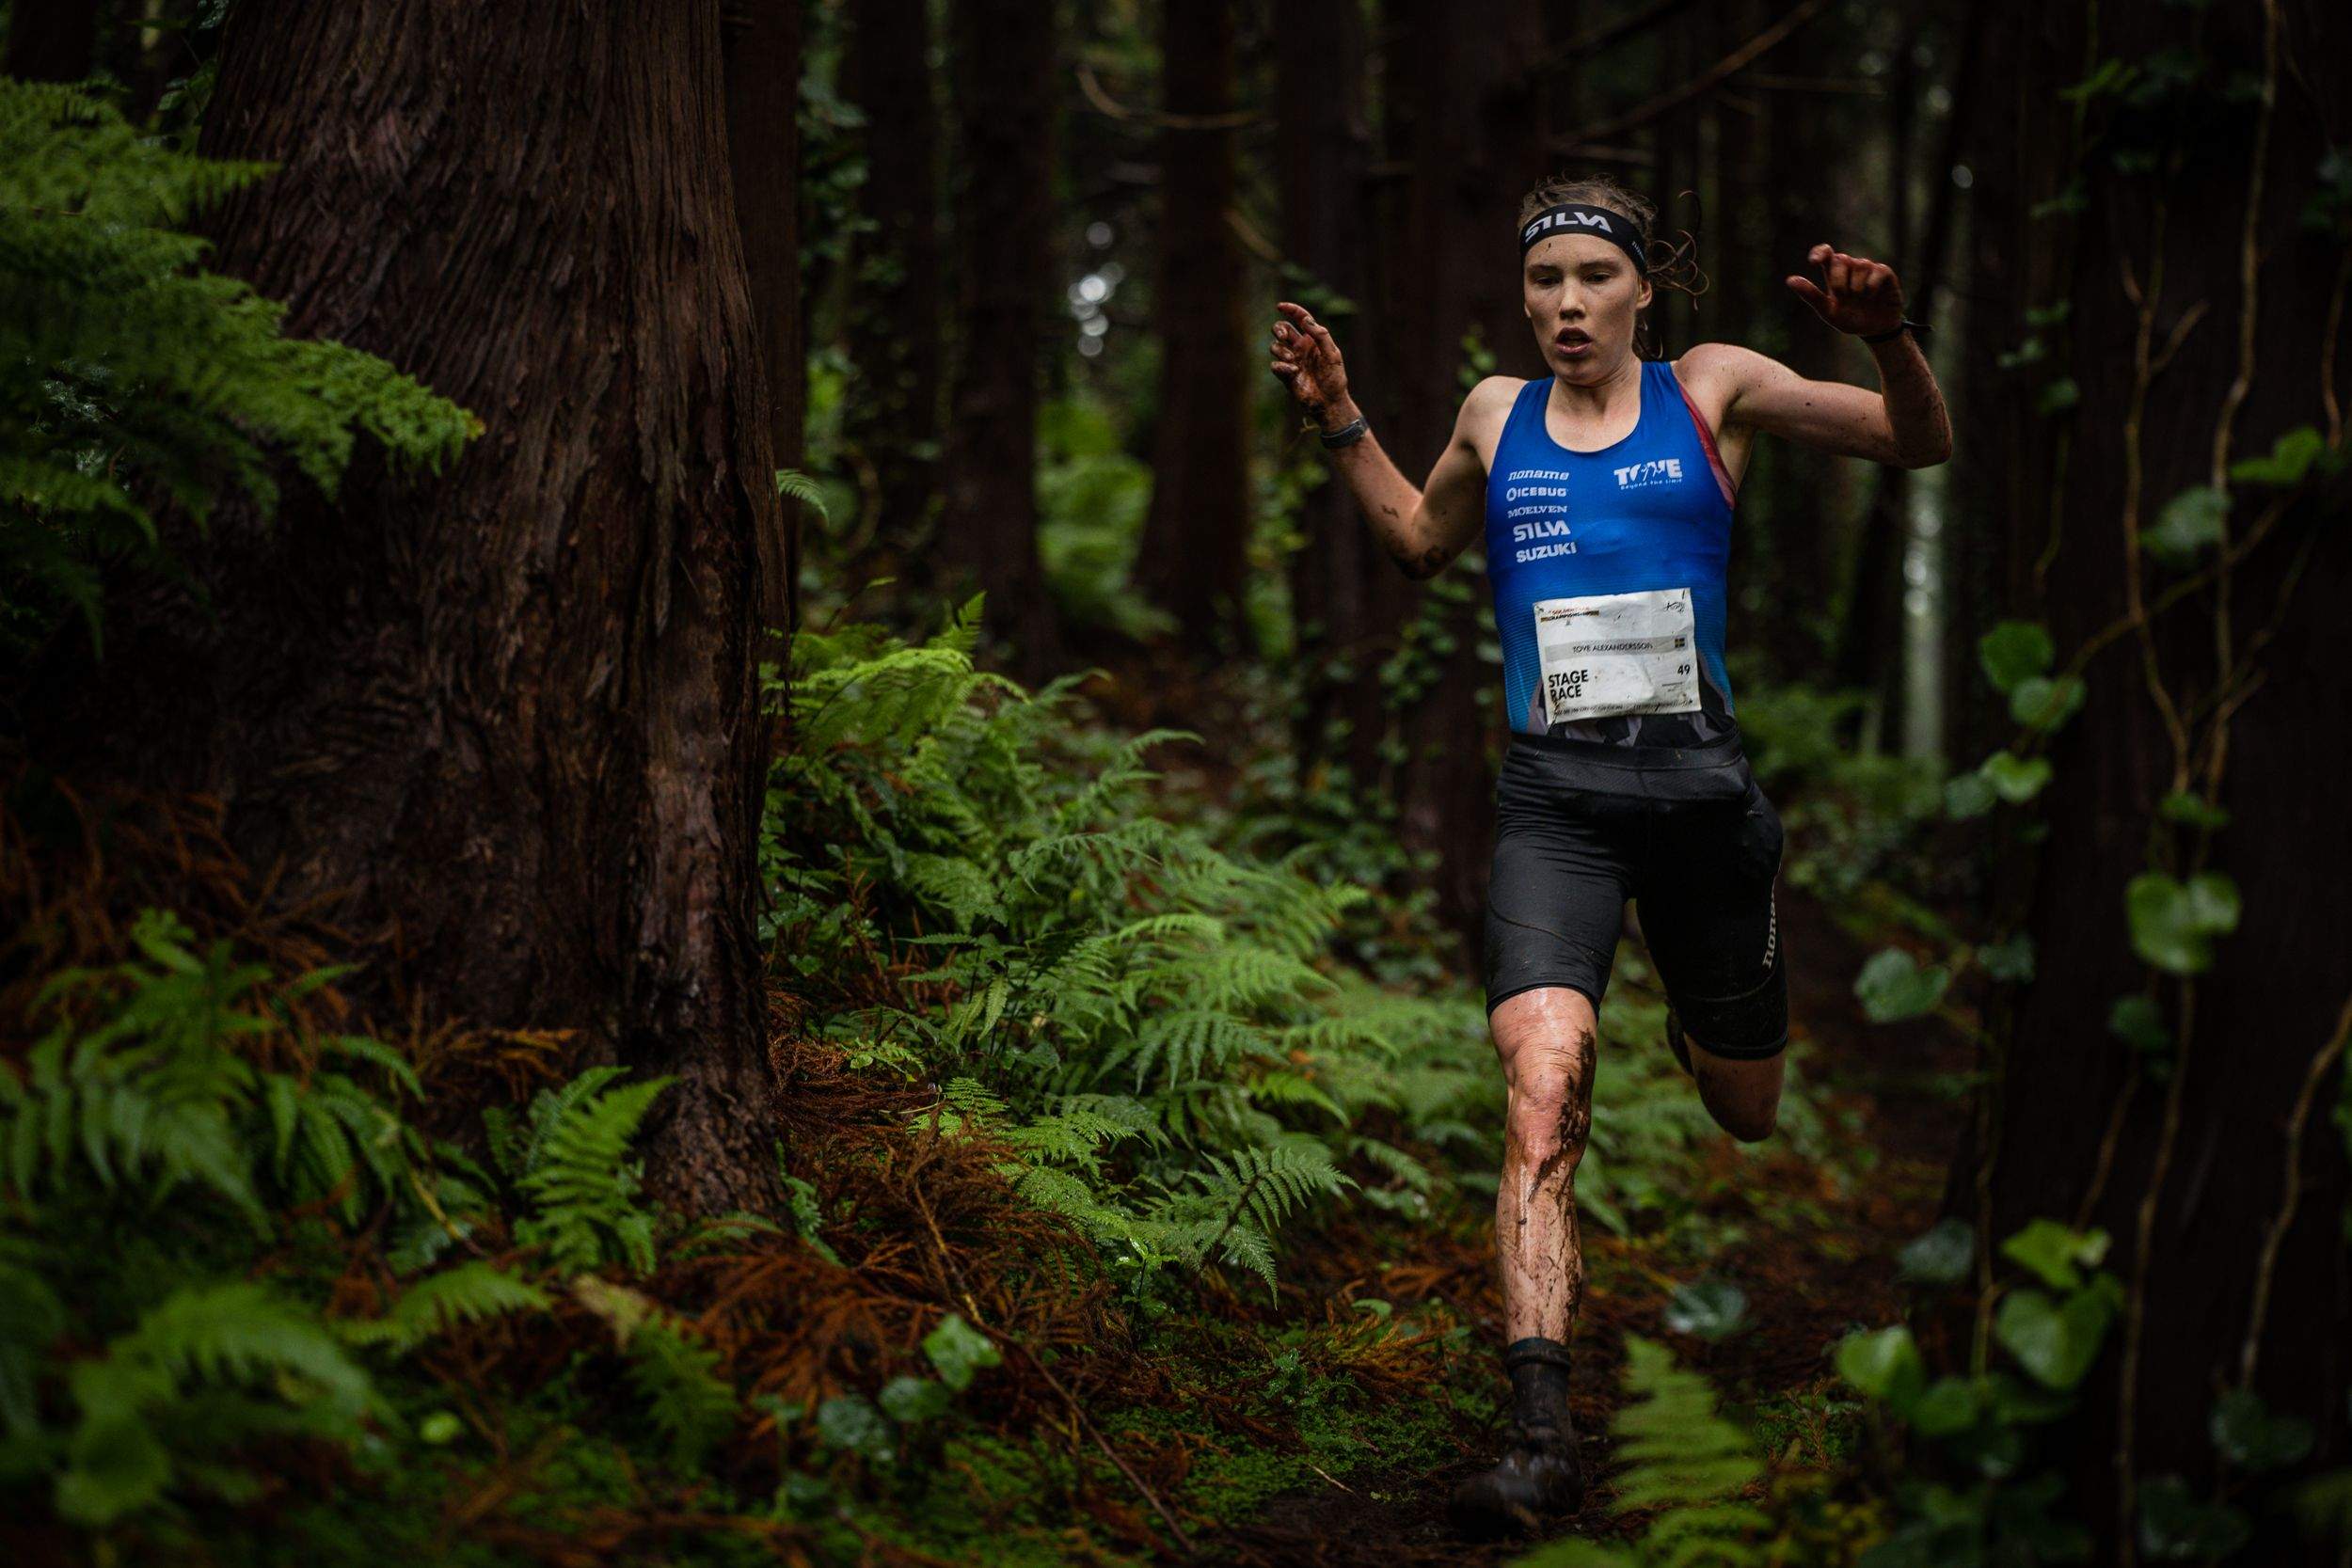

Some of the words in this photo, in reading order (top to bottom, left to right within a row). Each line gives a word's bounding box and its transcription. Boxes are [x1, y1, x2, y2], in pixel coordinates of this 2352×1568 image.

[1525, 212, 1613, 244] SILVA
[1508, 469, 1570, 482] noname
[1507, 505, 1568, 519] MOELVEN
[1513, 520, 1571, 543] SILVA
[1516, 542, 1578, 563] SUZUKI
[1548, 669, 1589, 689] STAGE
[1677, 663, 1691, 676] 49
[1549, 684, 1582, 703] RACE
